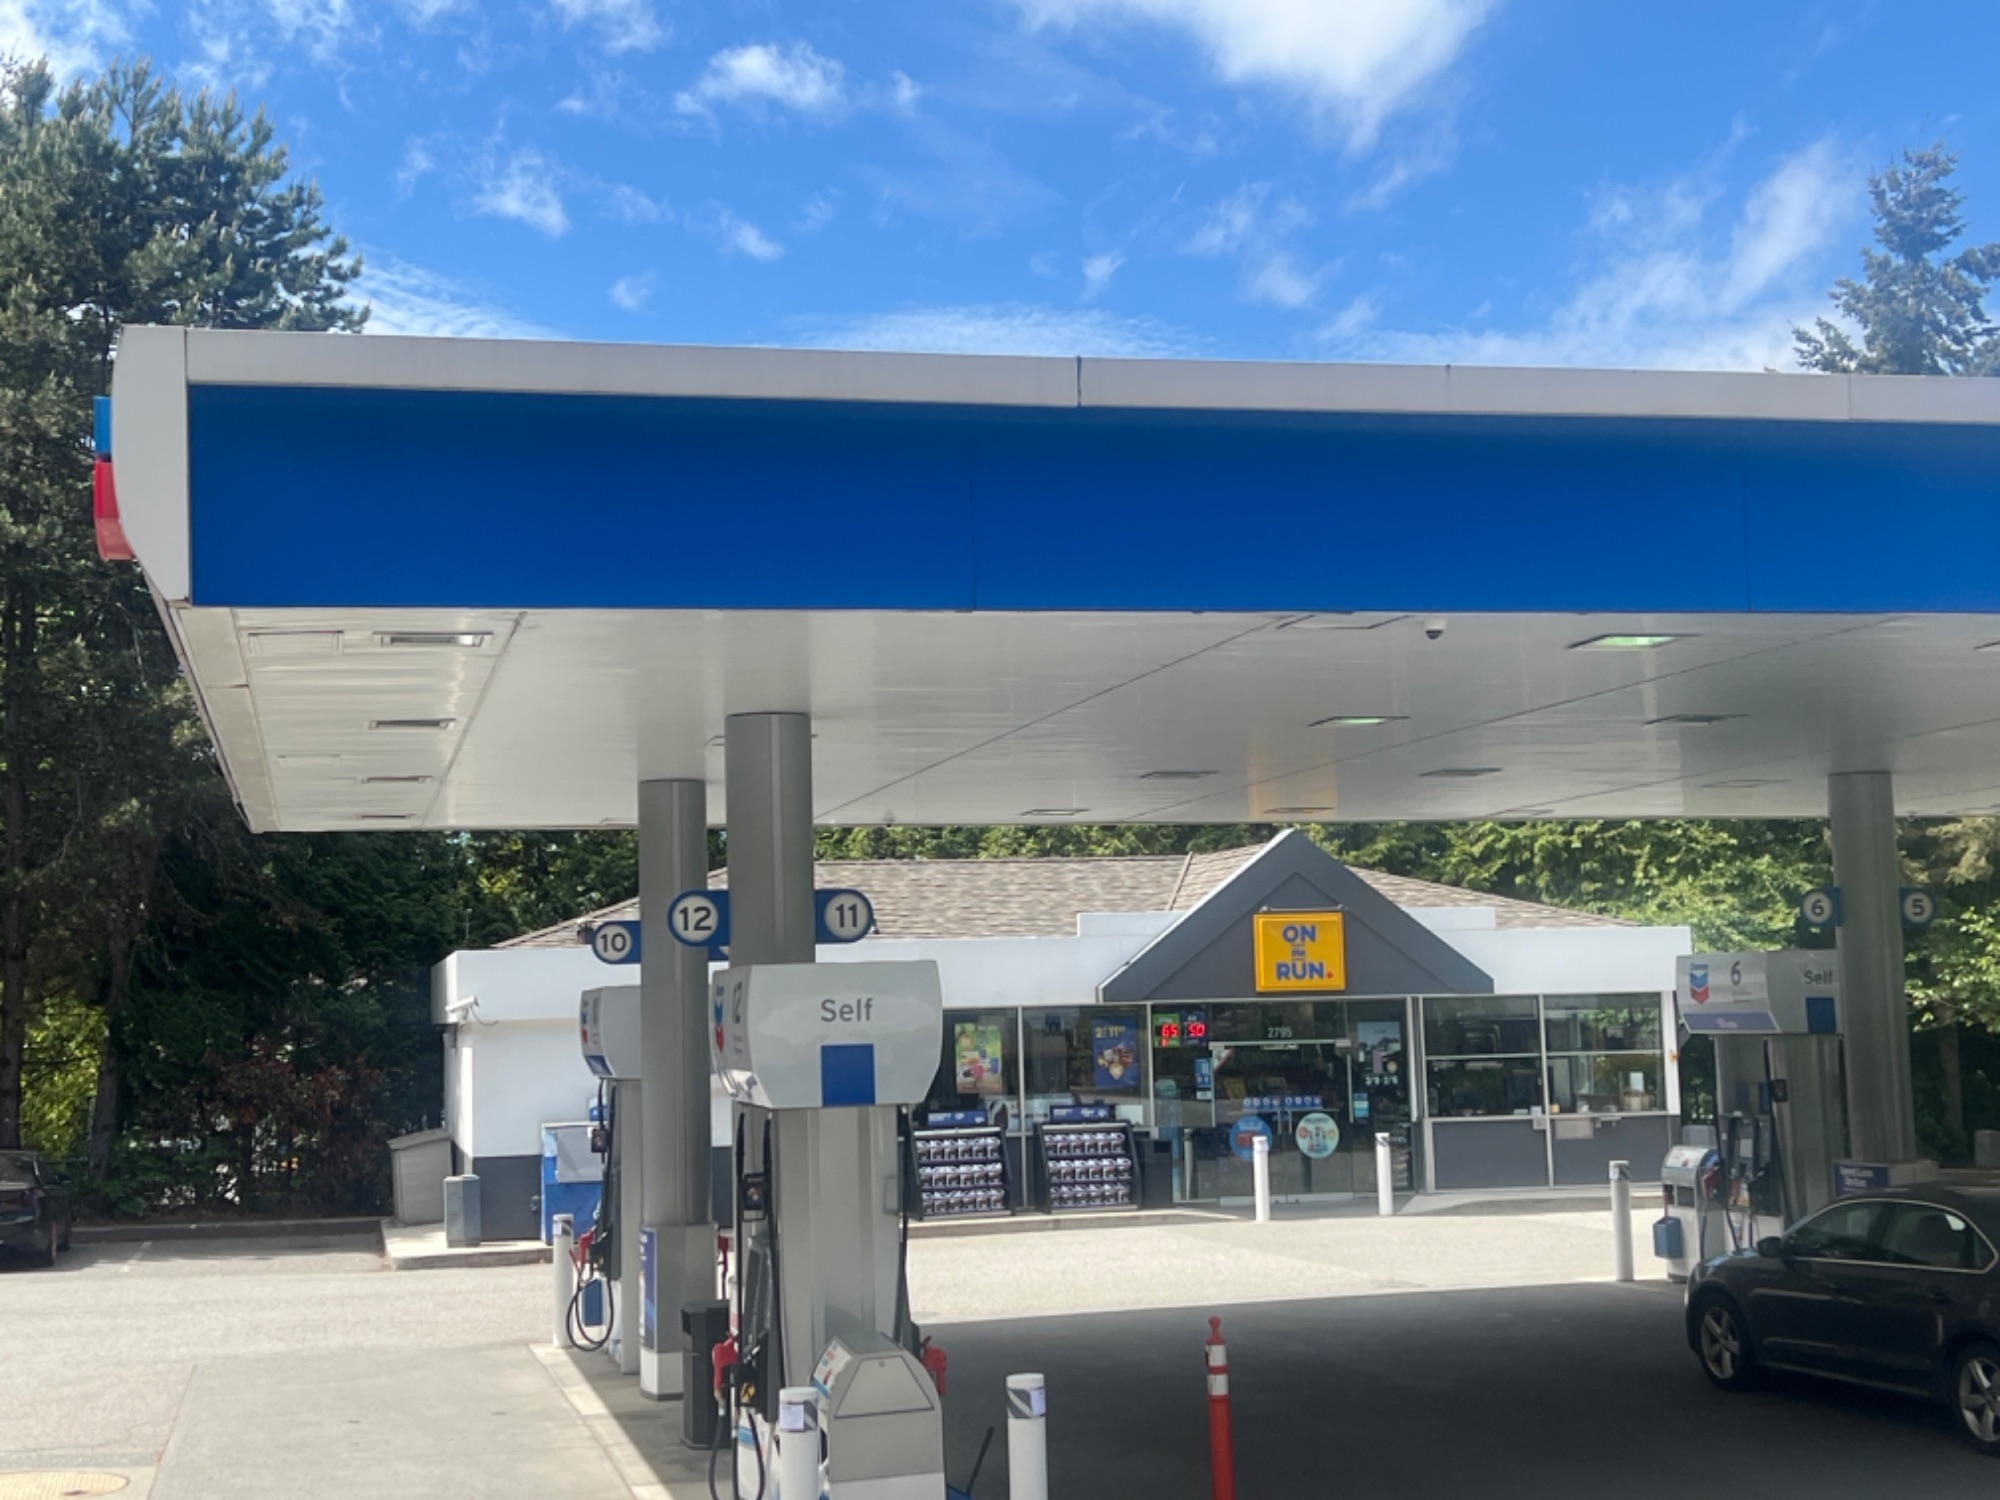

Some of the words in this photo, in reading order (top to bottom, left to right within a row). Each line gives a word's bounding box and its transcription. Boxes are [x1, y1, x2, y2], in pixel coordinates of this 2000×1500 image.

[835, 904, 858, 928] 11
[1811, 899, 1824, 917] 6
[1912, 898, 1925, 917] 5
[679, 906, 712, 931] 12
[600, 932, 627, 953] 10
[1282, 925, 1316, 943] ON
[1731, 960, 1741, 986] 6
[1803, 970, 1833, 985] Self
[820, 998, 873, 1022] Self
